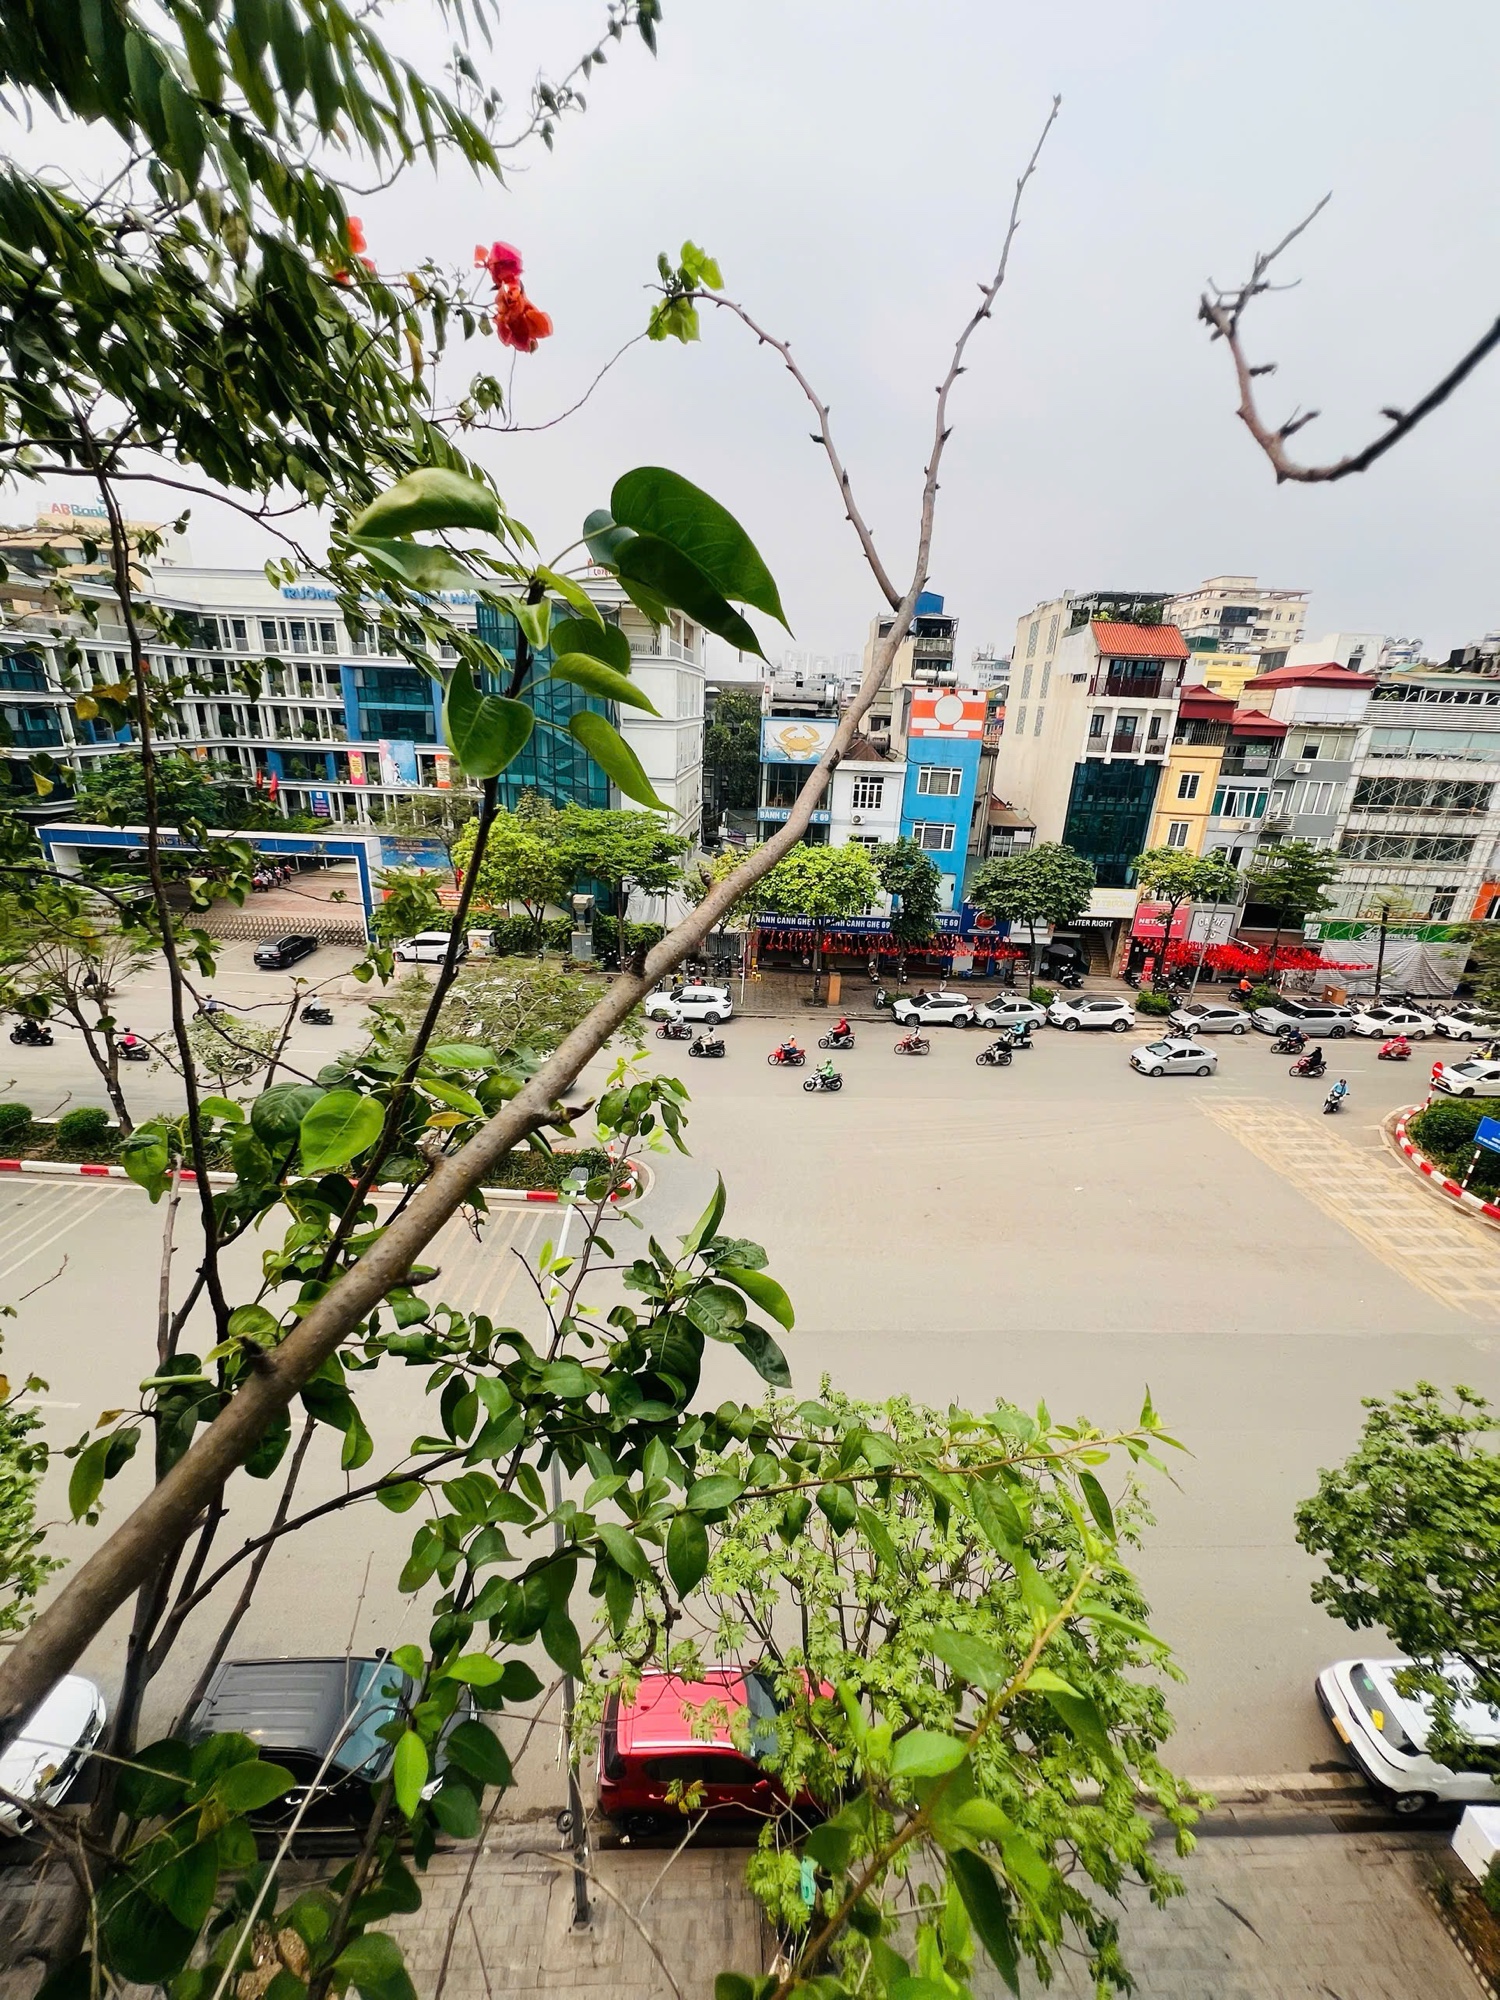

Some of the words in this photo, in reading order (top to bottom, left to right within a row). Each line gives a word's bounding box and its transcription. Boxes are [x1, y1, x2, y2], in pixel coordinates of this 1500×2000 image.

[51, 503, 107, 518] ABBank
[760, 809, 780, 819] BÁNH
[756, 915, 775, 924] BÁNH
[777, 917, 796, 925] CANH
[797, 918, 811, 927] GHẸ
[846, 919, 865, 928] CANH
[866, 921, 880, 930] GHẸ
[881, 921, 891, 929] 69
[949, 919, 959, 927] 69
[1091, 919, 1114, 927] RIGHT
